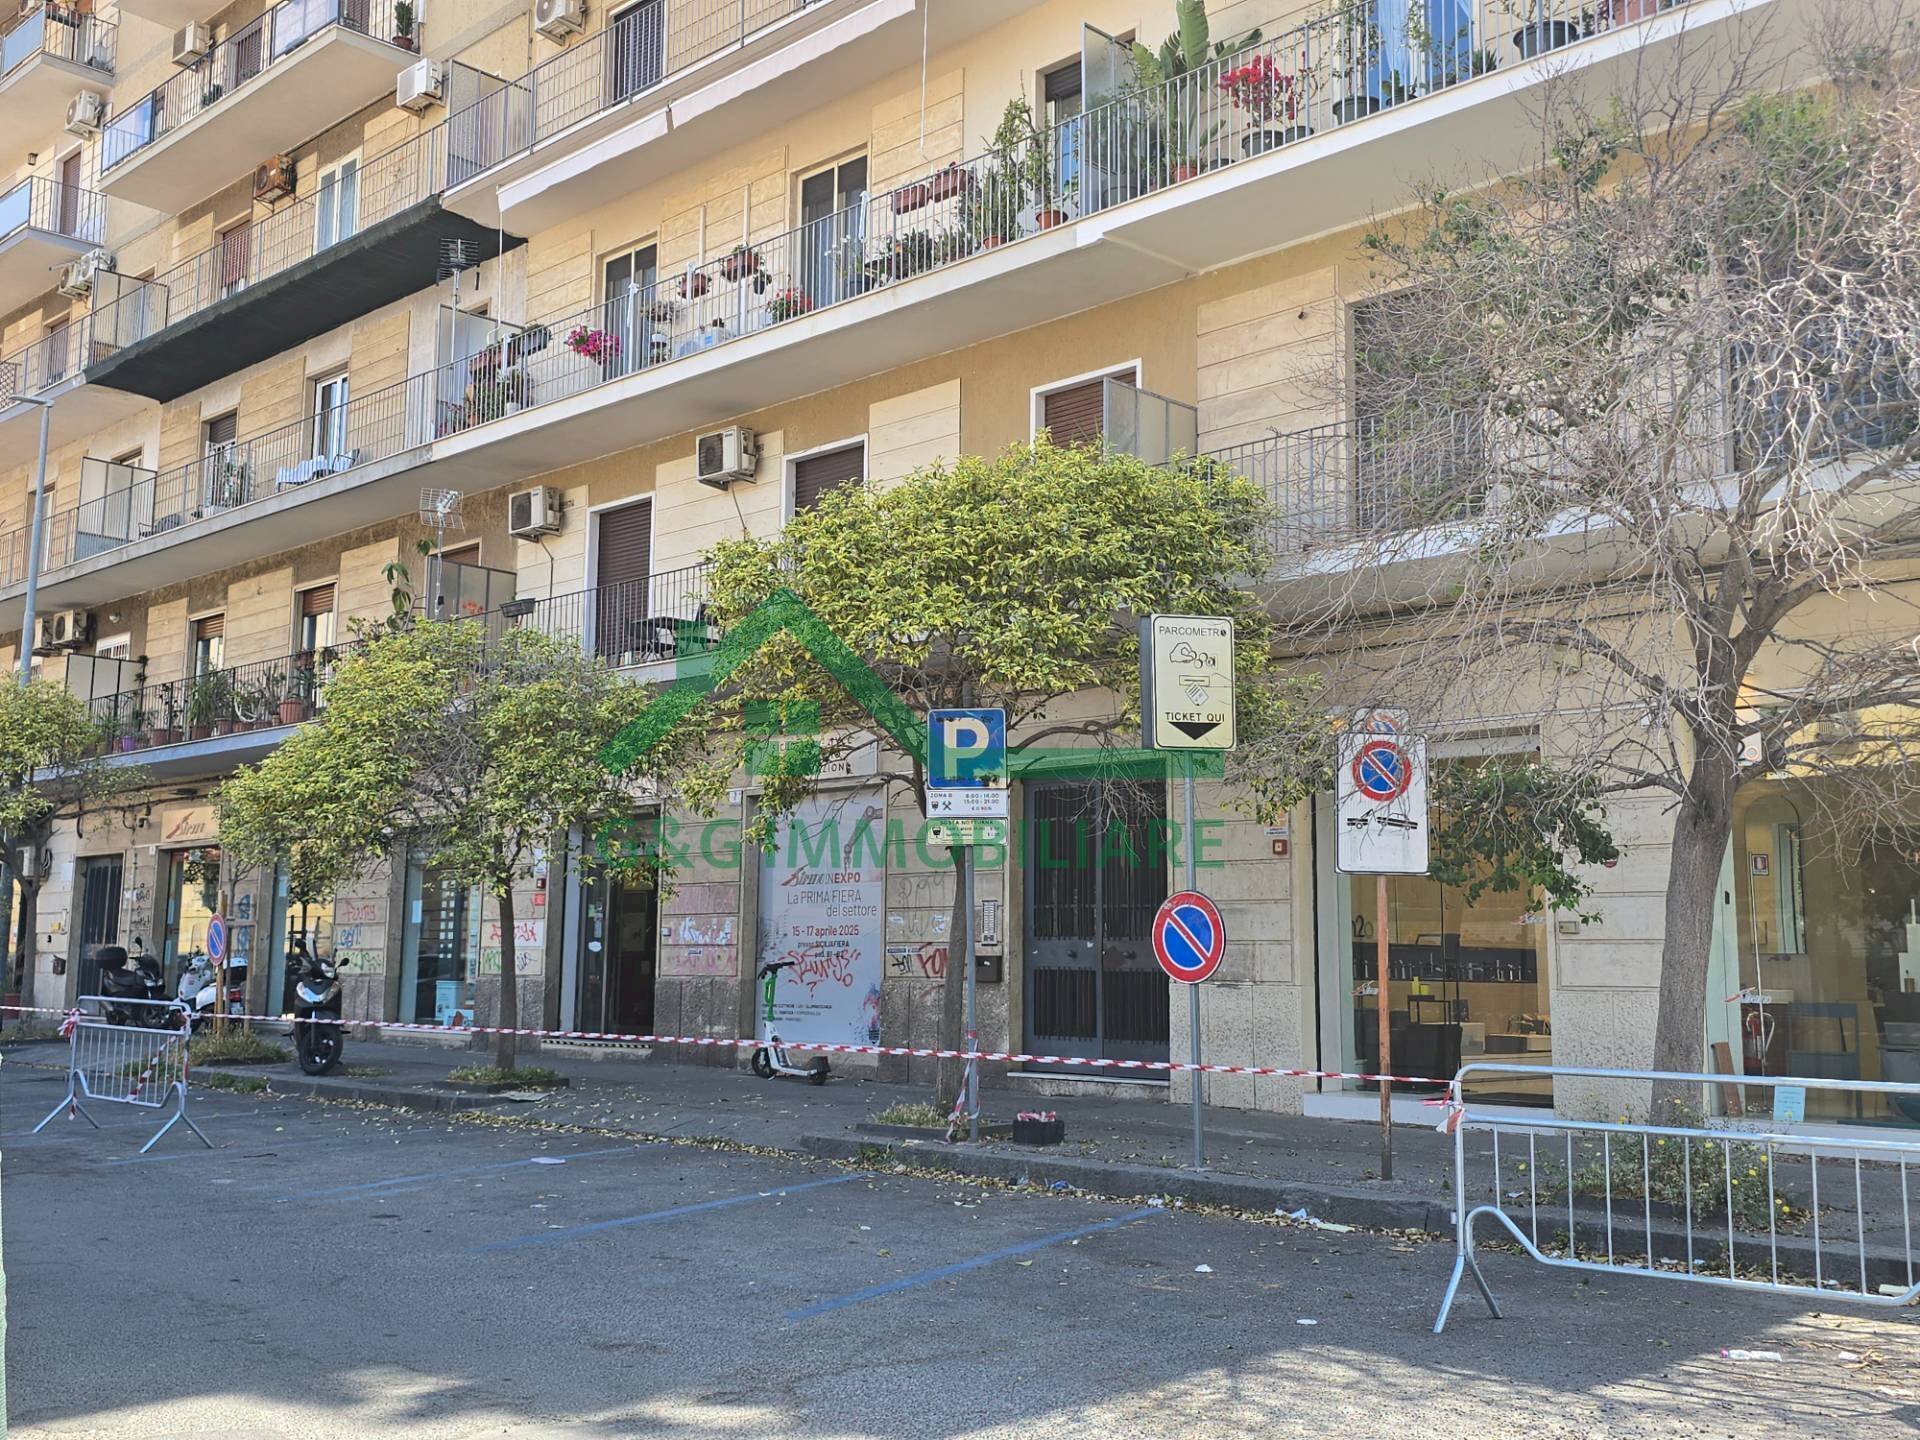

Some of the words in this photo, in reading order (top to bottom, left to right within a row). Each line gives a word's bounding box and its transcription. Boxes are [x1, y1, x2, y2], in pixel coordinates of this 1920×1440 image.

[1165, 711, 1202, 721] TICKET
[1206, 713, 1225, 722] QUI
[943, 716, 990, 780] P
[787, 891, 799, 904] La
[801, 890, 830, 904] PRIMA
[832, 889, 861, 903] FIERA
[826, 904, 841, 917] del
[842, 905, 877, 917] settore
[792, 925, 801, 936] 15
[806, 925, 814, 936] 17
[815, 925, 838, 938] aprile
[839, 925, 859, 936] 2025
